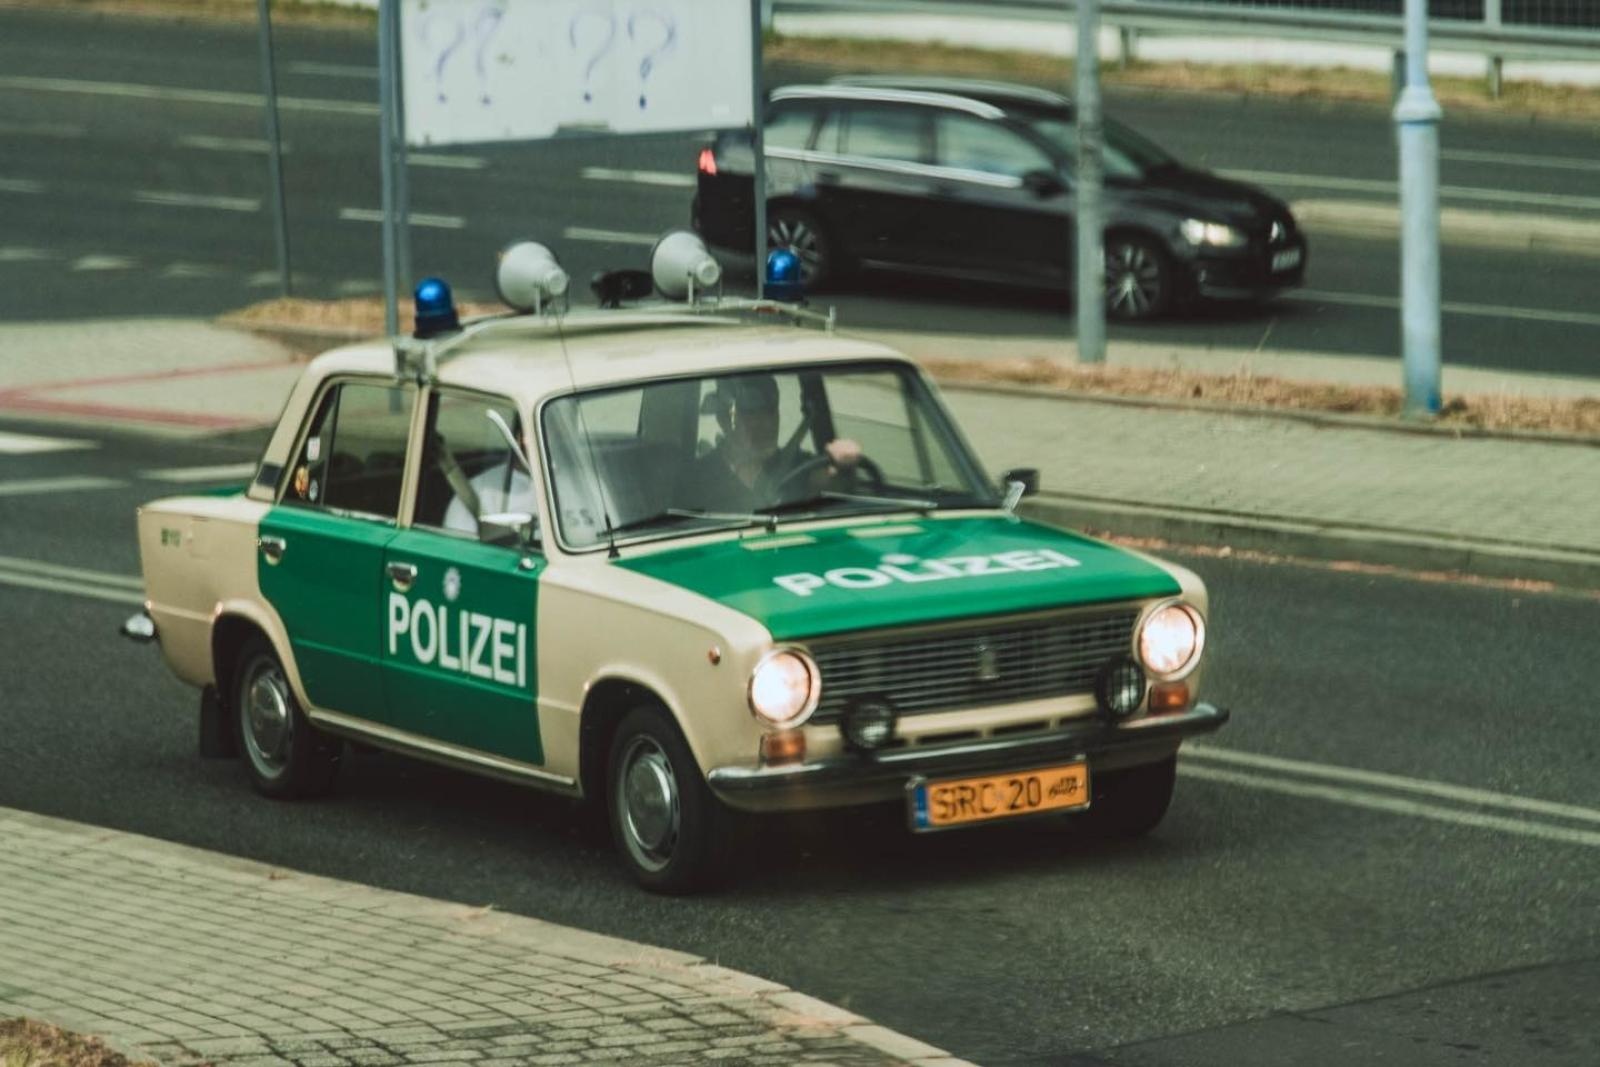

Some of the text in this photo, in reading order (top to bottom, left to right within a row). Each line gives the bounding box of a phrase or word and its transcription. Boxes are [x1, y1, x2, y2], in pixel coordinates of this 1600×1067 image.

[773, 549, 1082, 596] POLIZEI
[389, 591, 527, 688] POLIZEI
[1008, 776, 1042, 810] 20
